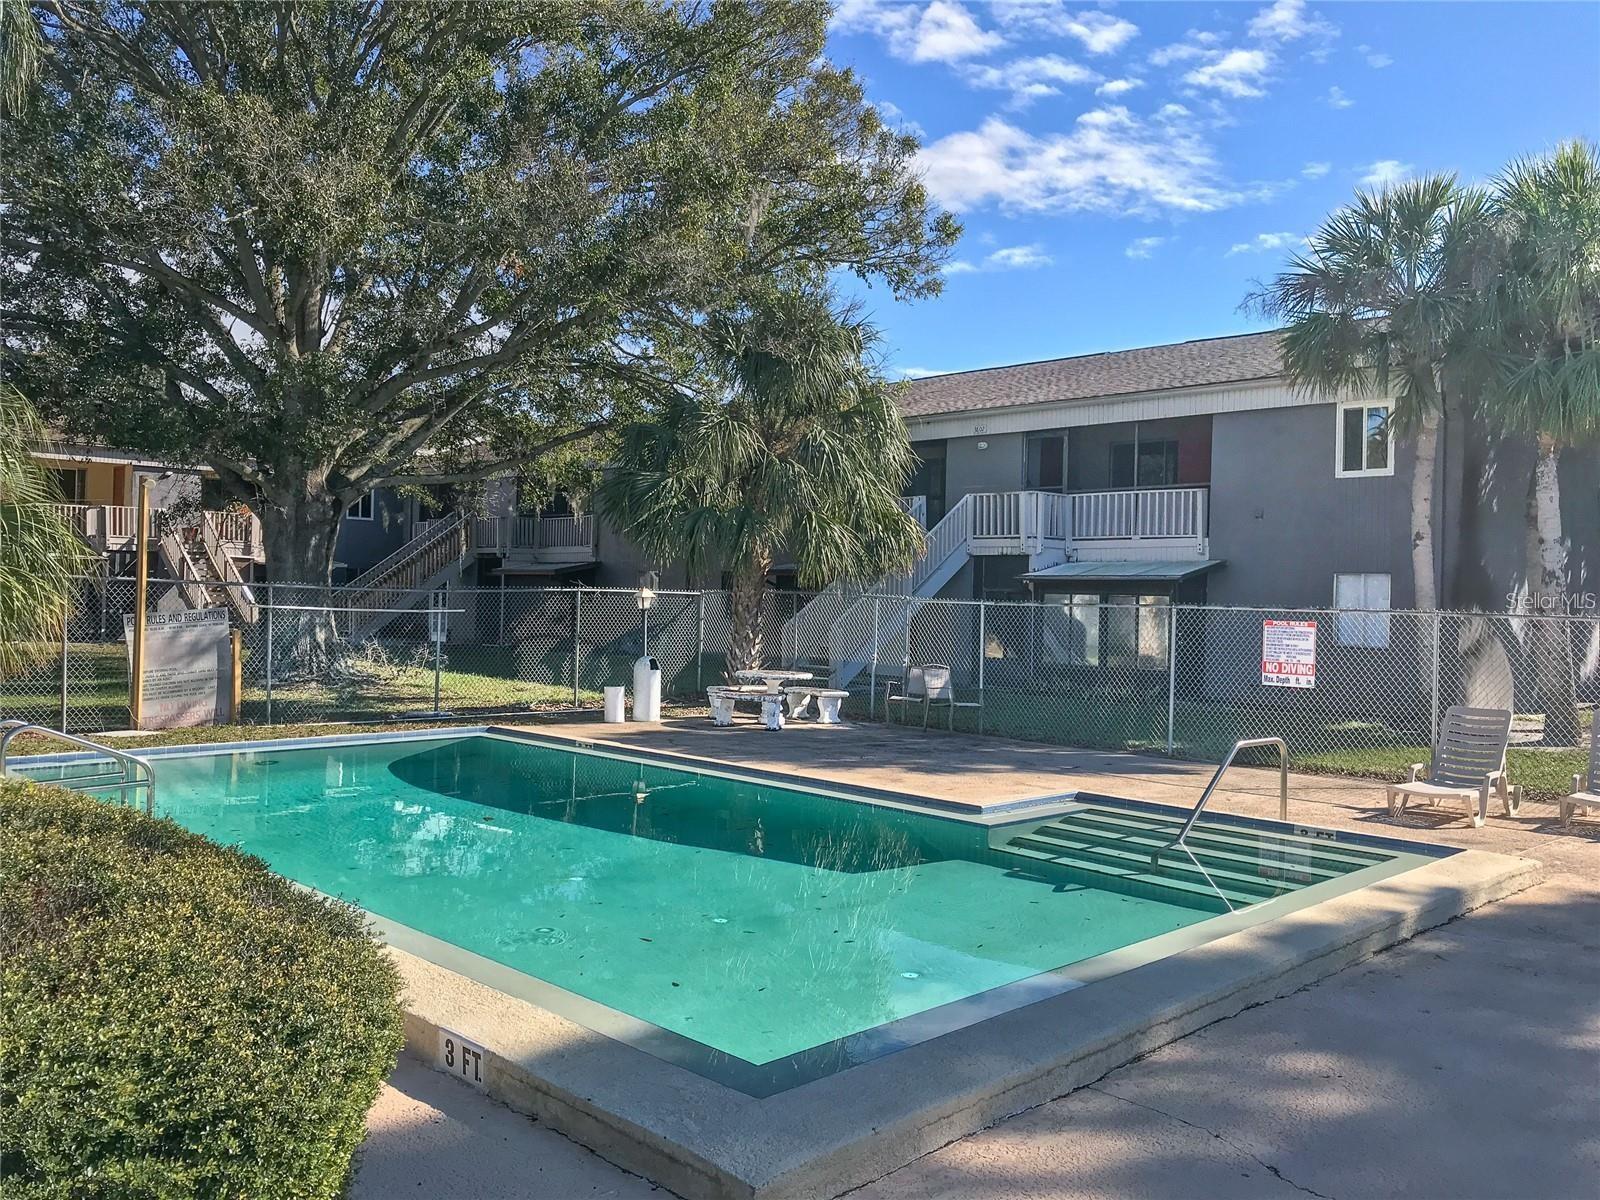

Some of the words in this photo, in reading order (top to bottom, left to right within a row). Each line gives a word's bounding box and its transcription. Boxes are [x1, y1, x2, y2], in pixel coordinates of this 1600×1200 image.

[146, 614, 166, 625] RULES
[168, 613, 182, 623] AND
[184, 610, 226, 622] REGULATIONS
[1265, 662, 1279, 673] NO
[1281, 663, 1313, 675] DIVING
[1275, 675, 1290, 685] Depth
[445, 1038, 455, 1067] 3
